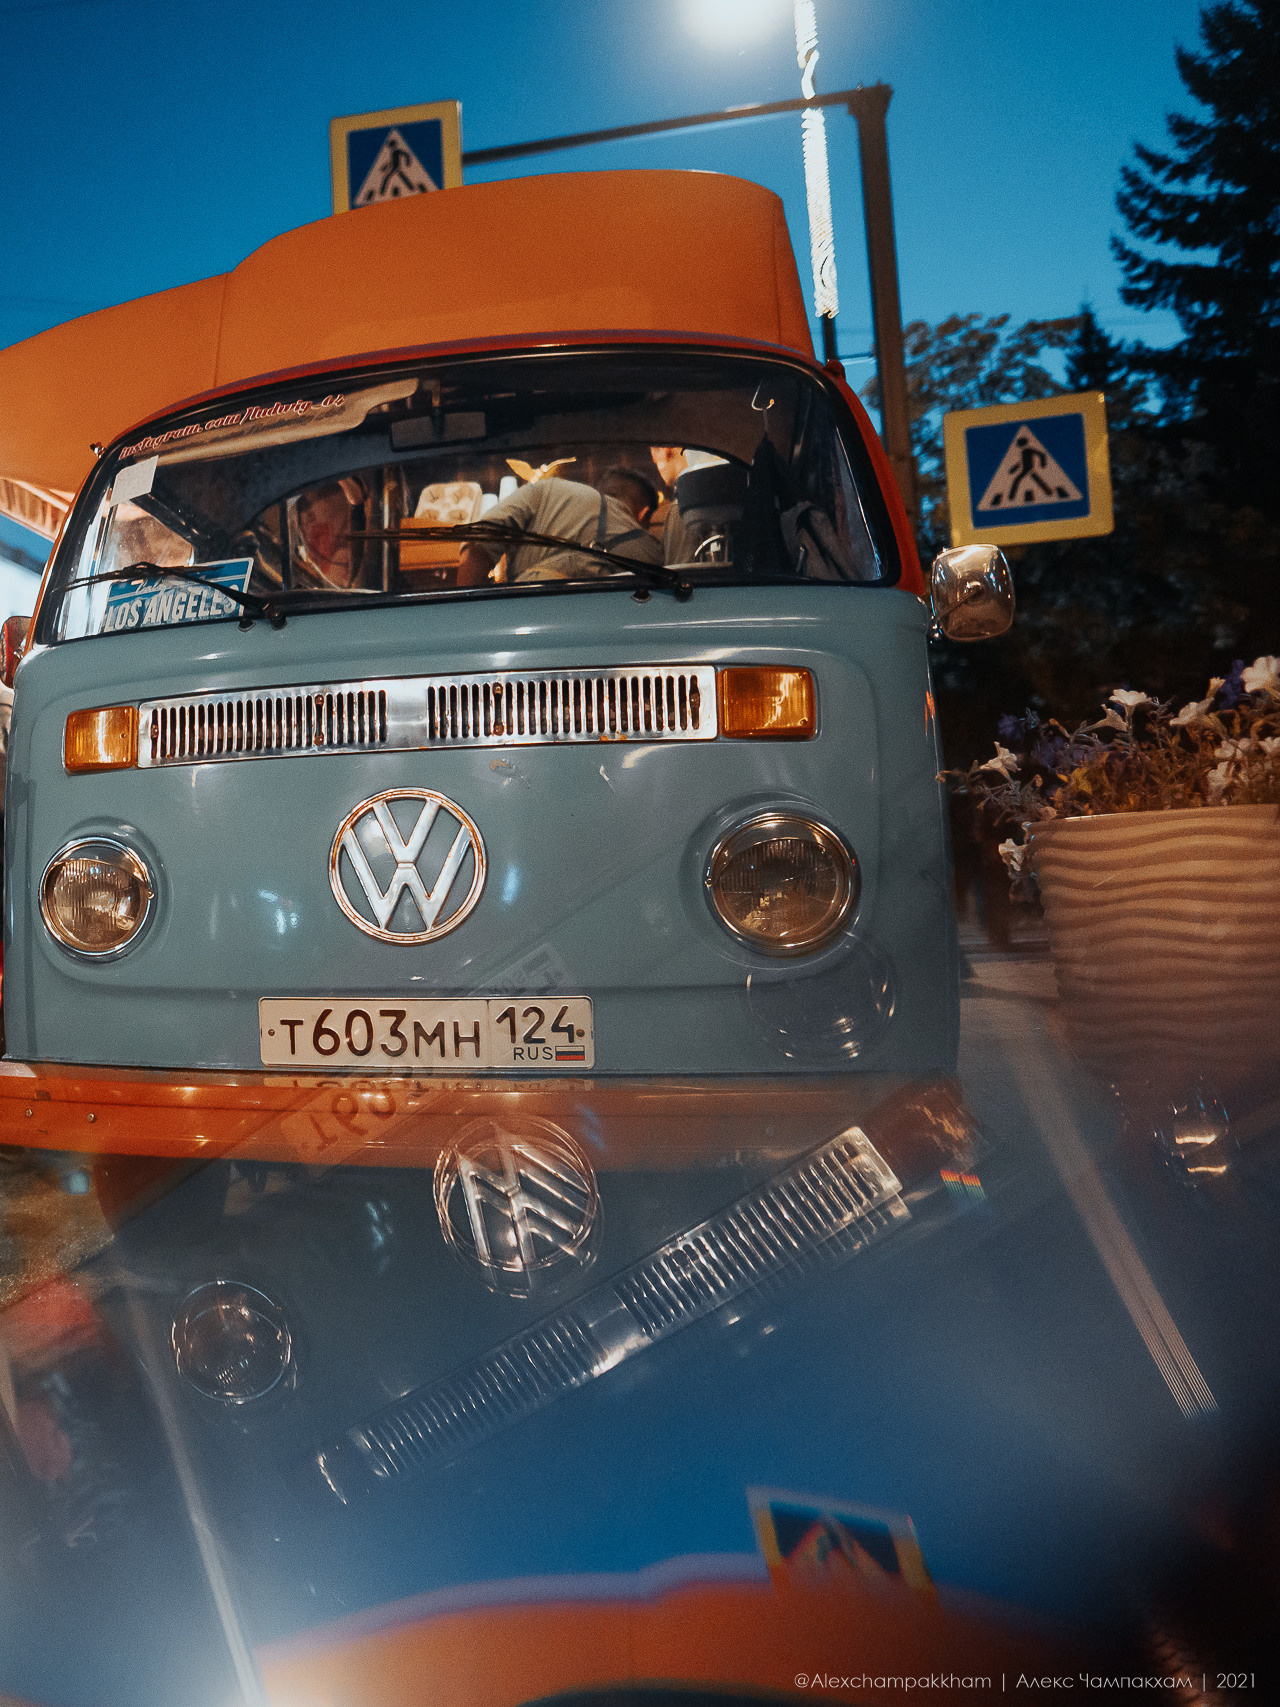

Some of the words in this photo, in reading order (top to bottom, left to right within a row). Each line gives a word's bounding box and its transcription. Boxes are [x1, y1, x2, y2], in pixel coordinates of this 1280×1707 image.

[103, 598, 142, 633] LOS
[495, 1005, 577, 1044] 124
[512, 1046, 554, 1061] RUS
